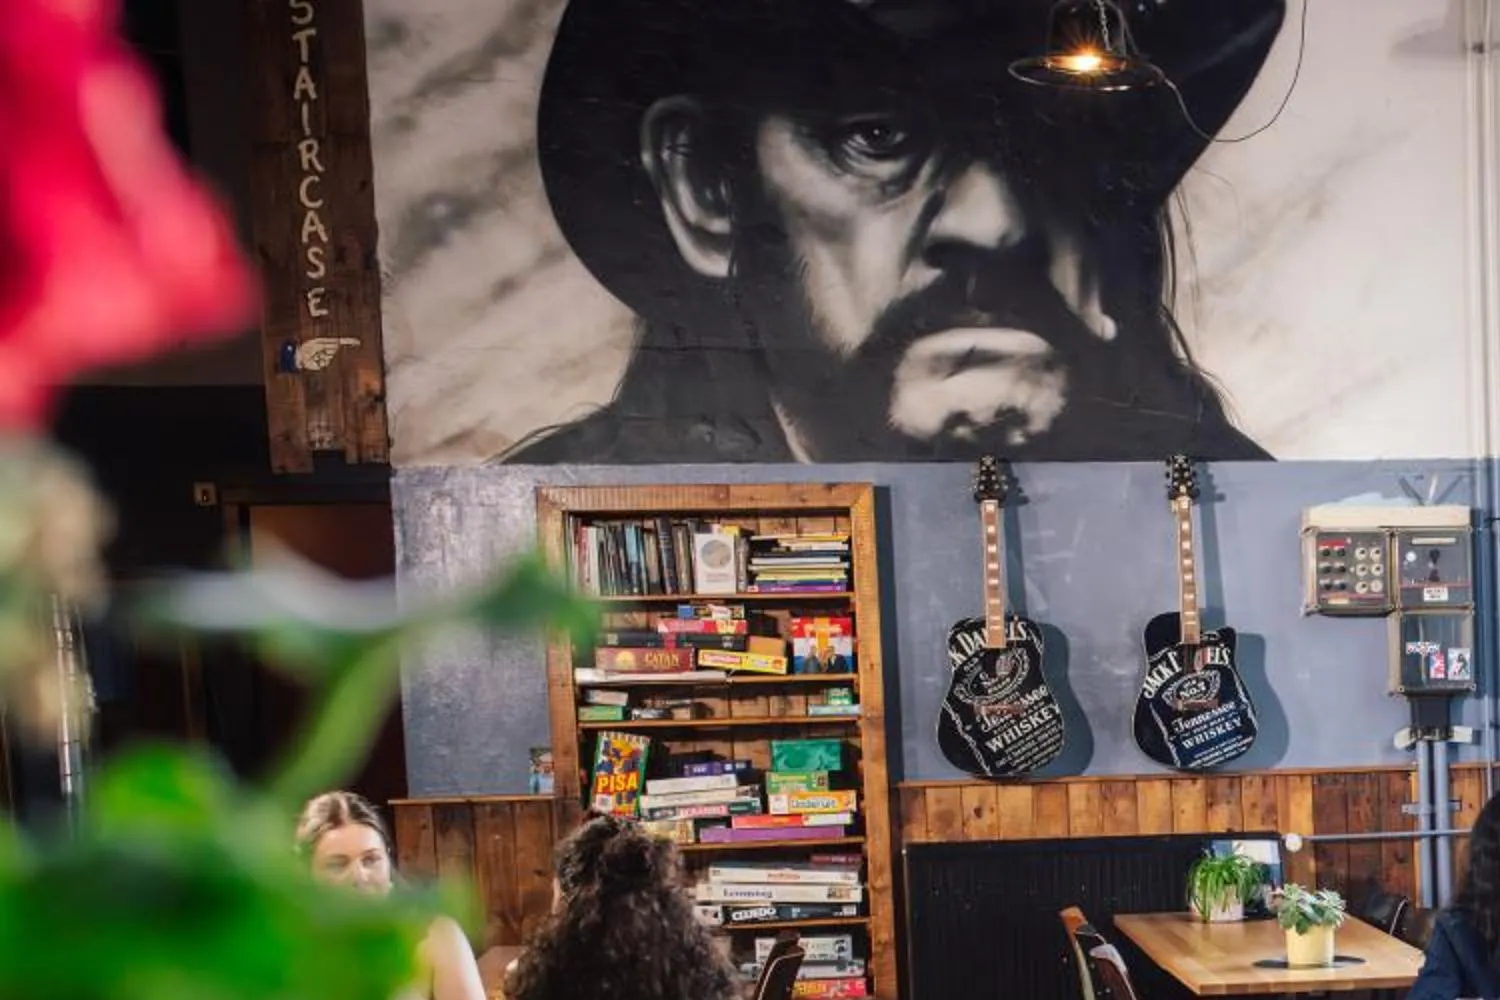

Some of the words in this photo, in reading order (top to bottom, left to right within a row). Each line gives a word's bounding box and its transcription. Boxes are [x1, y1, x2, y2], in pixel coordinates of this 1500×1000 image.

[290, 0, 328, 317] STAIRCASE
[644, 652, 680, 668] CATAN
[985, 703, 1060, 752] WHISKEY
[1182, 717, 1241, 749] WHISKEY
[597, 772, 637, 792] PISA
